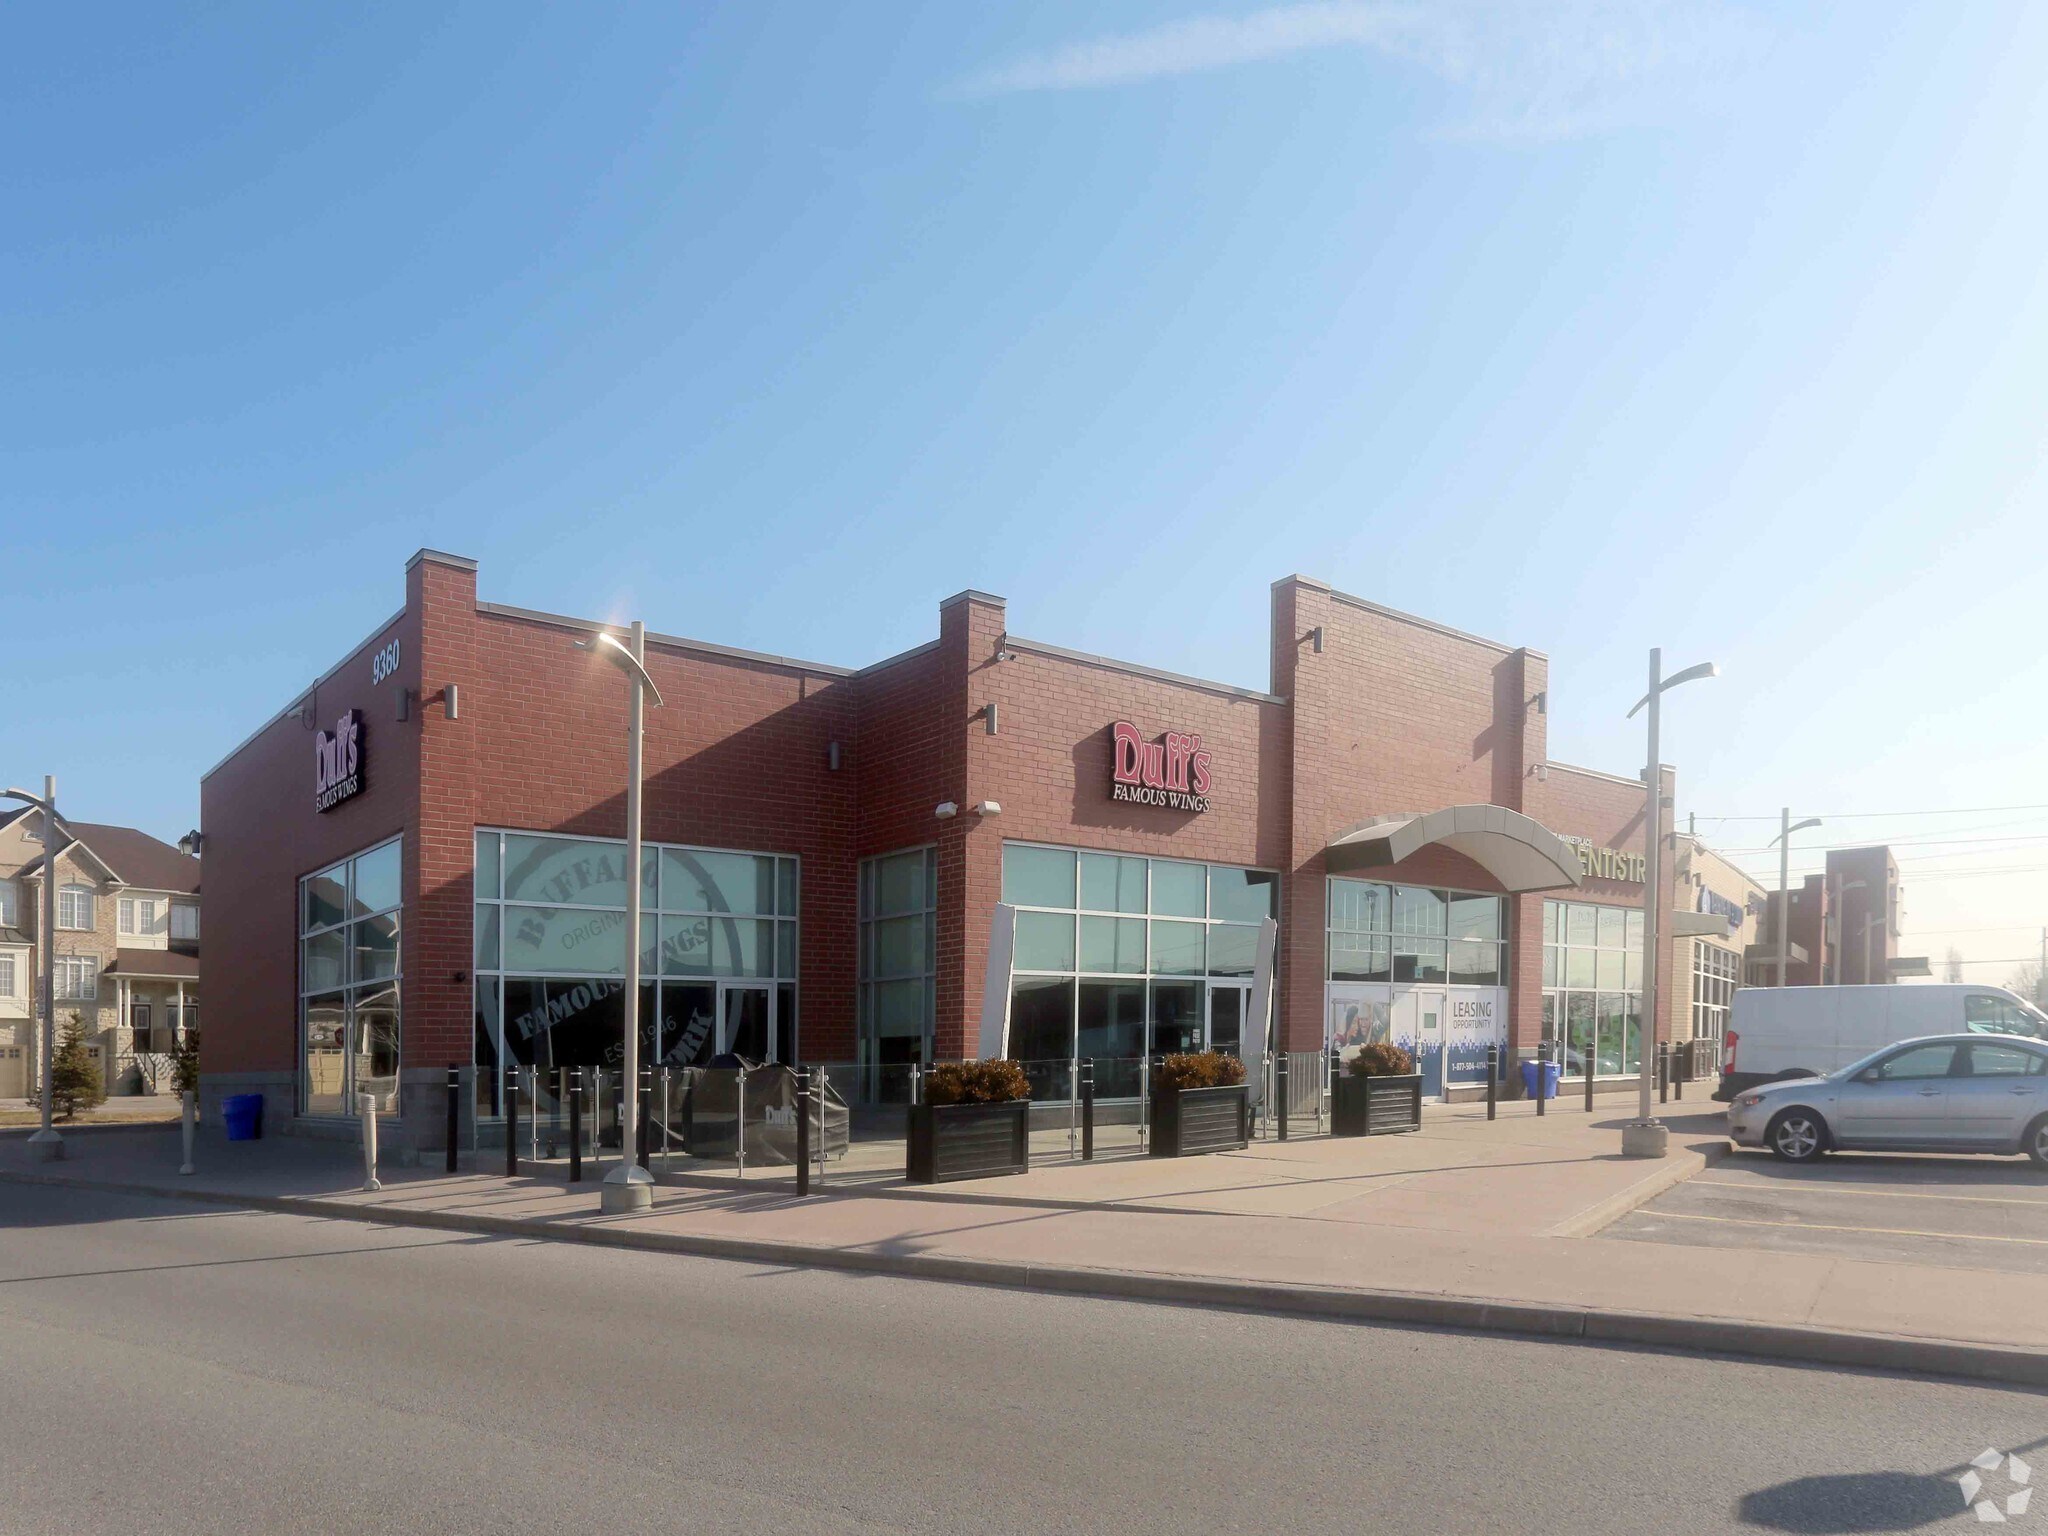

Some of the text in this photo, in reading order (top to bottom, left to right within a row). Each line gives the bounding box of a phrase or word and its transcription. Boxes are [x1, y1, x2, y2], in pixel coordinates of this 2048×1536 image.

[373, 638, 400, 686] 9360
[316, 709, 358, 795] Duff's
[1113, 721, 1212, 794] Duff's
[316, 774, 358, 813] FAMOUS WINGS
[1113, 784, 1211, 813] FAMOUS WINGS
[1566, 843, 1646, 883] ENTISTR
[1453, 1002, 1492, 1018] LEASING
[1453, 1019, 1491, 1030] OPPORTUNITY
